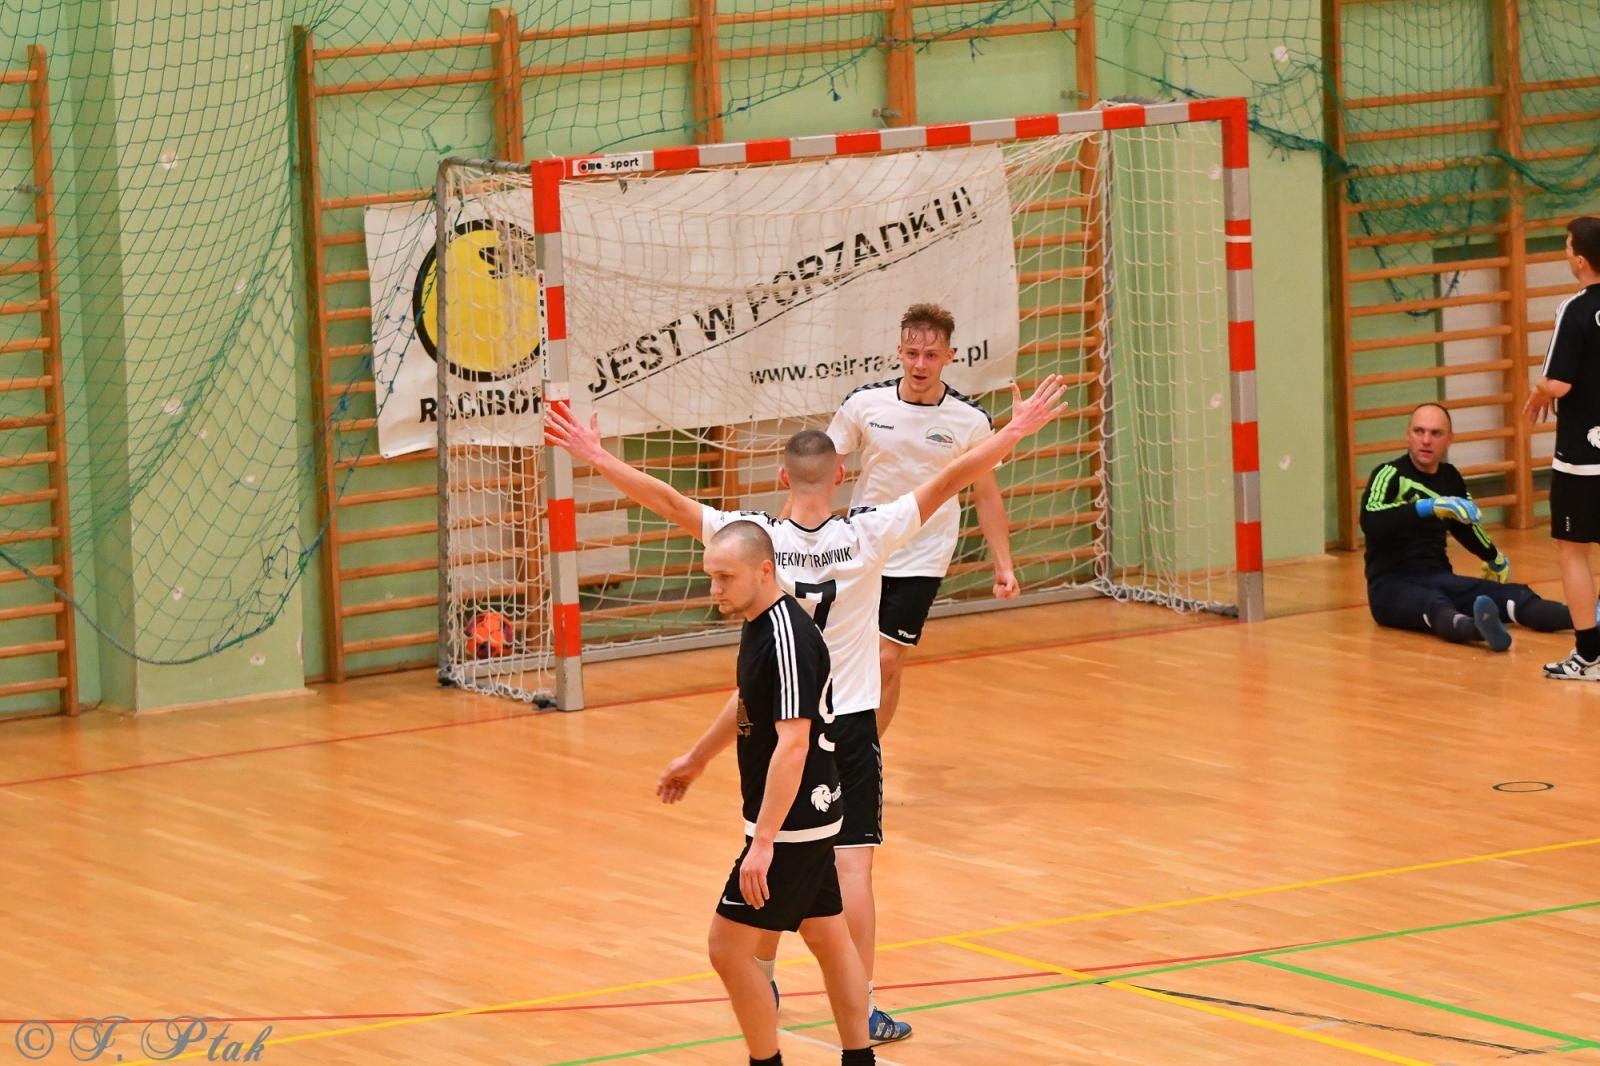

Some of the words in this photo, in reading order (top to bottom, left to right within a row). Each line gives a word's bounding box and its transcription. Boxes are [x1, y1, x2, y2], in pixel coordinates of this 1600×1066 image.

[610, 157, 639, 170] sport
[587, 318, 683, 394] JEST
[693, 298, 736, 342] W
[809, 546, 853, 568] TRAWNIK
[795, 579, 837, 634] 7
